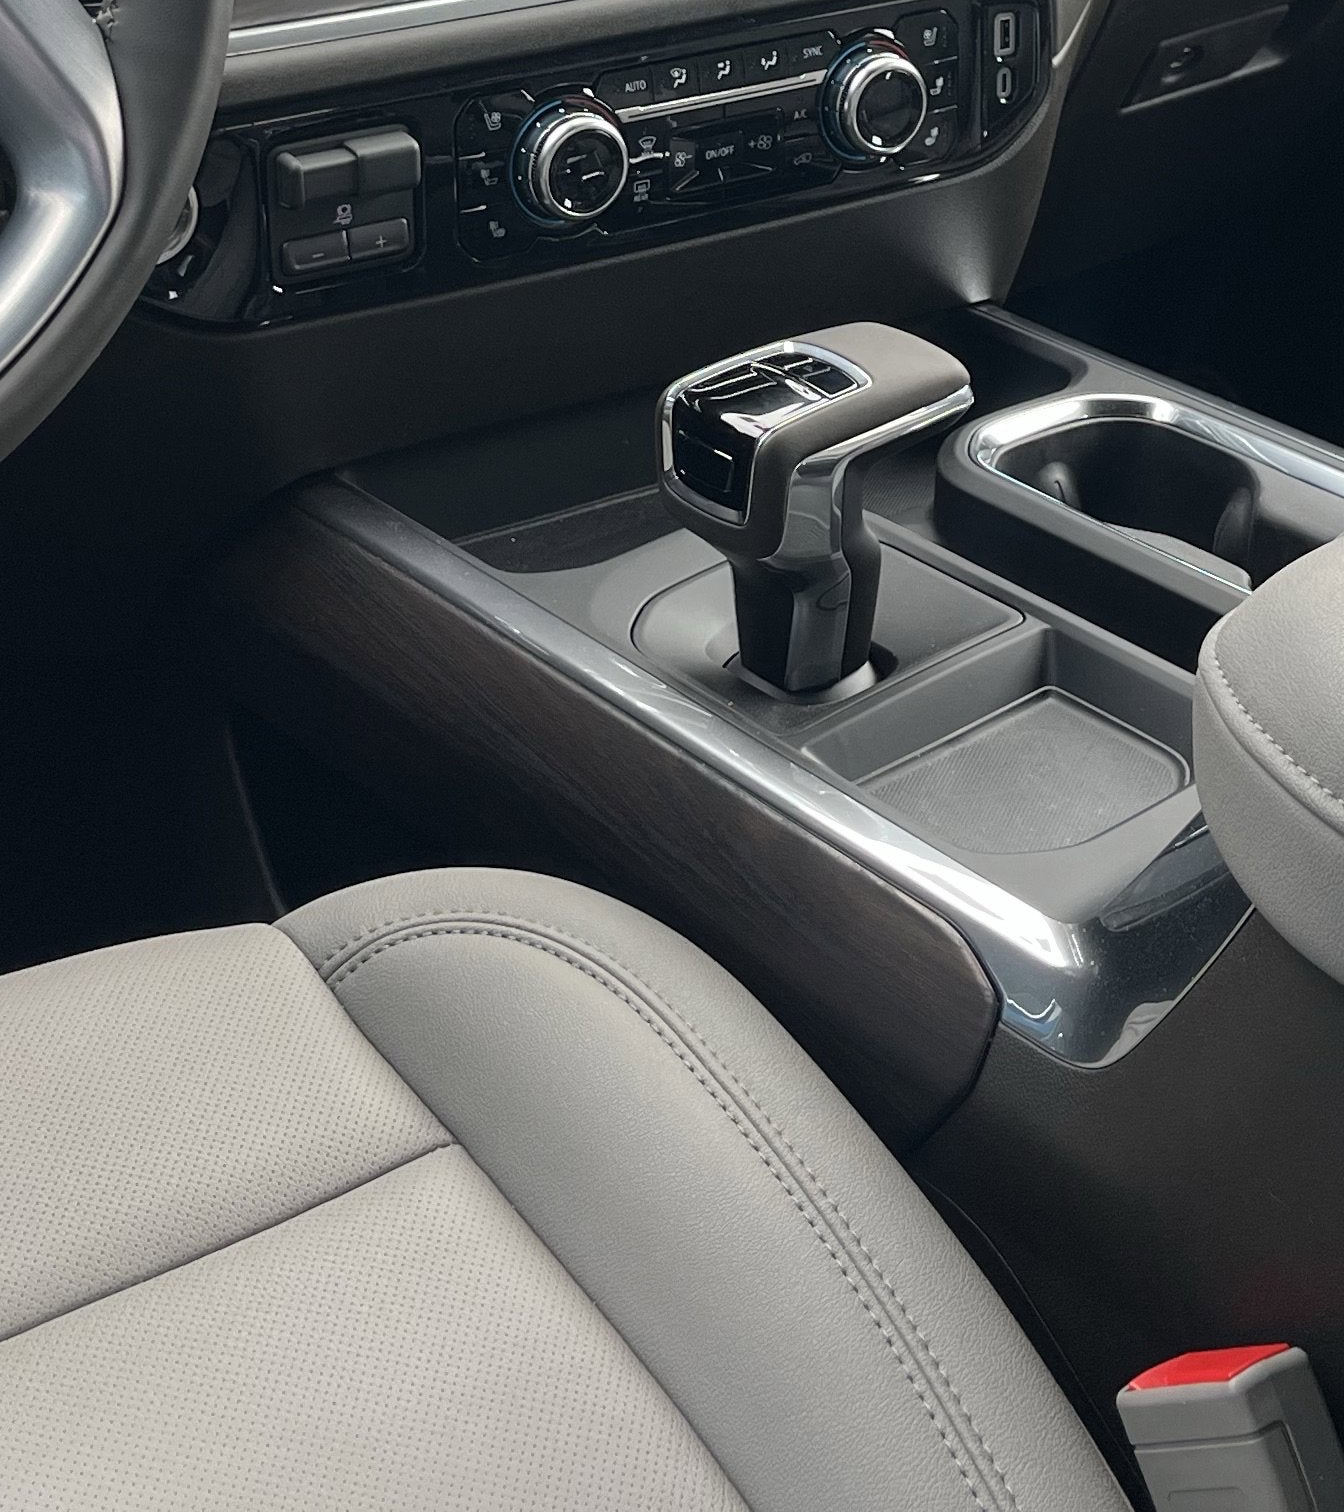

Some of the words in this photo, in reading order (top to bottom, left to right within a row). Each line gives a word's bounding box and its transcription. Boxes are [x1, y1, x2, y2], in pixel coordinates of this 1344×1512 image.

[803, 46, 823, 59] SYNC
[625, 80, 647, 93] AUTO
[706, 145, 735, 160] ON/OFF
